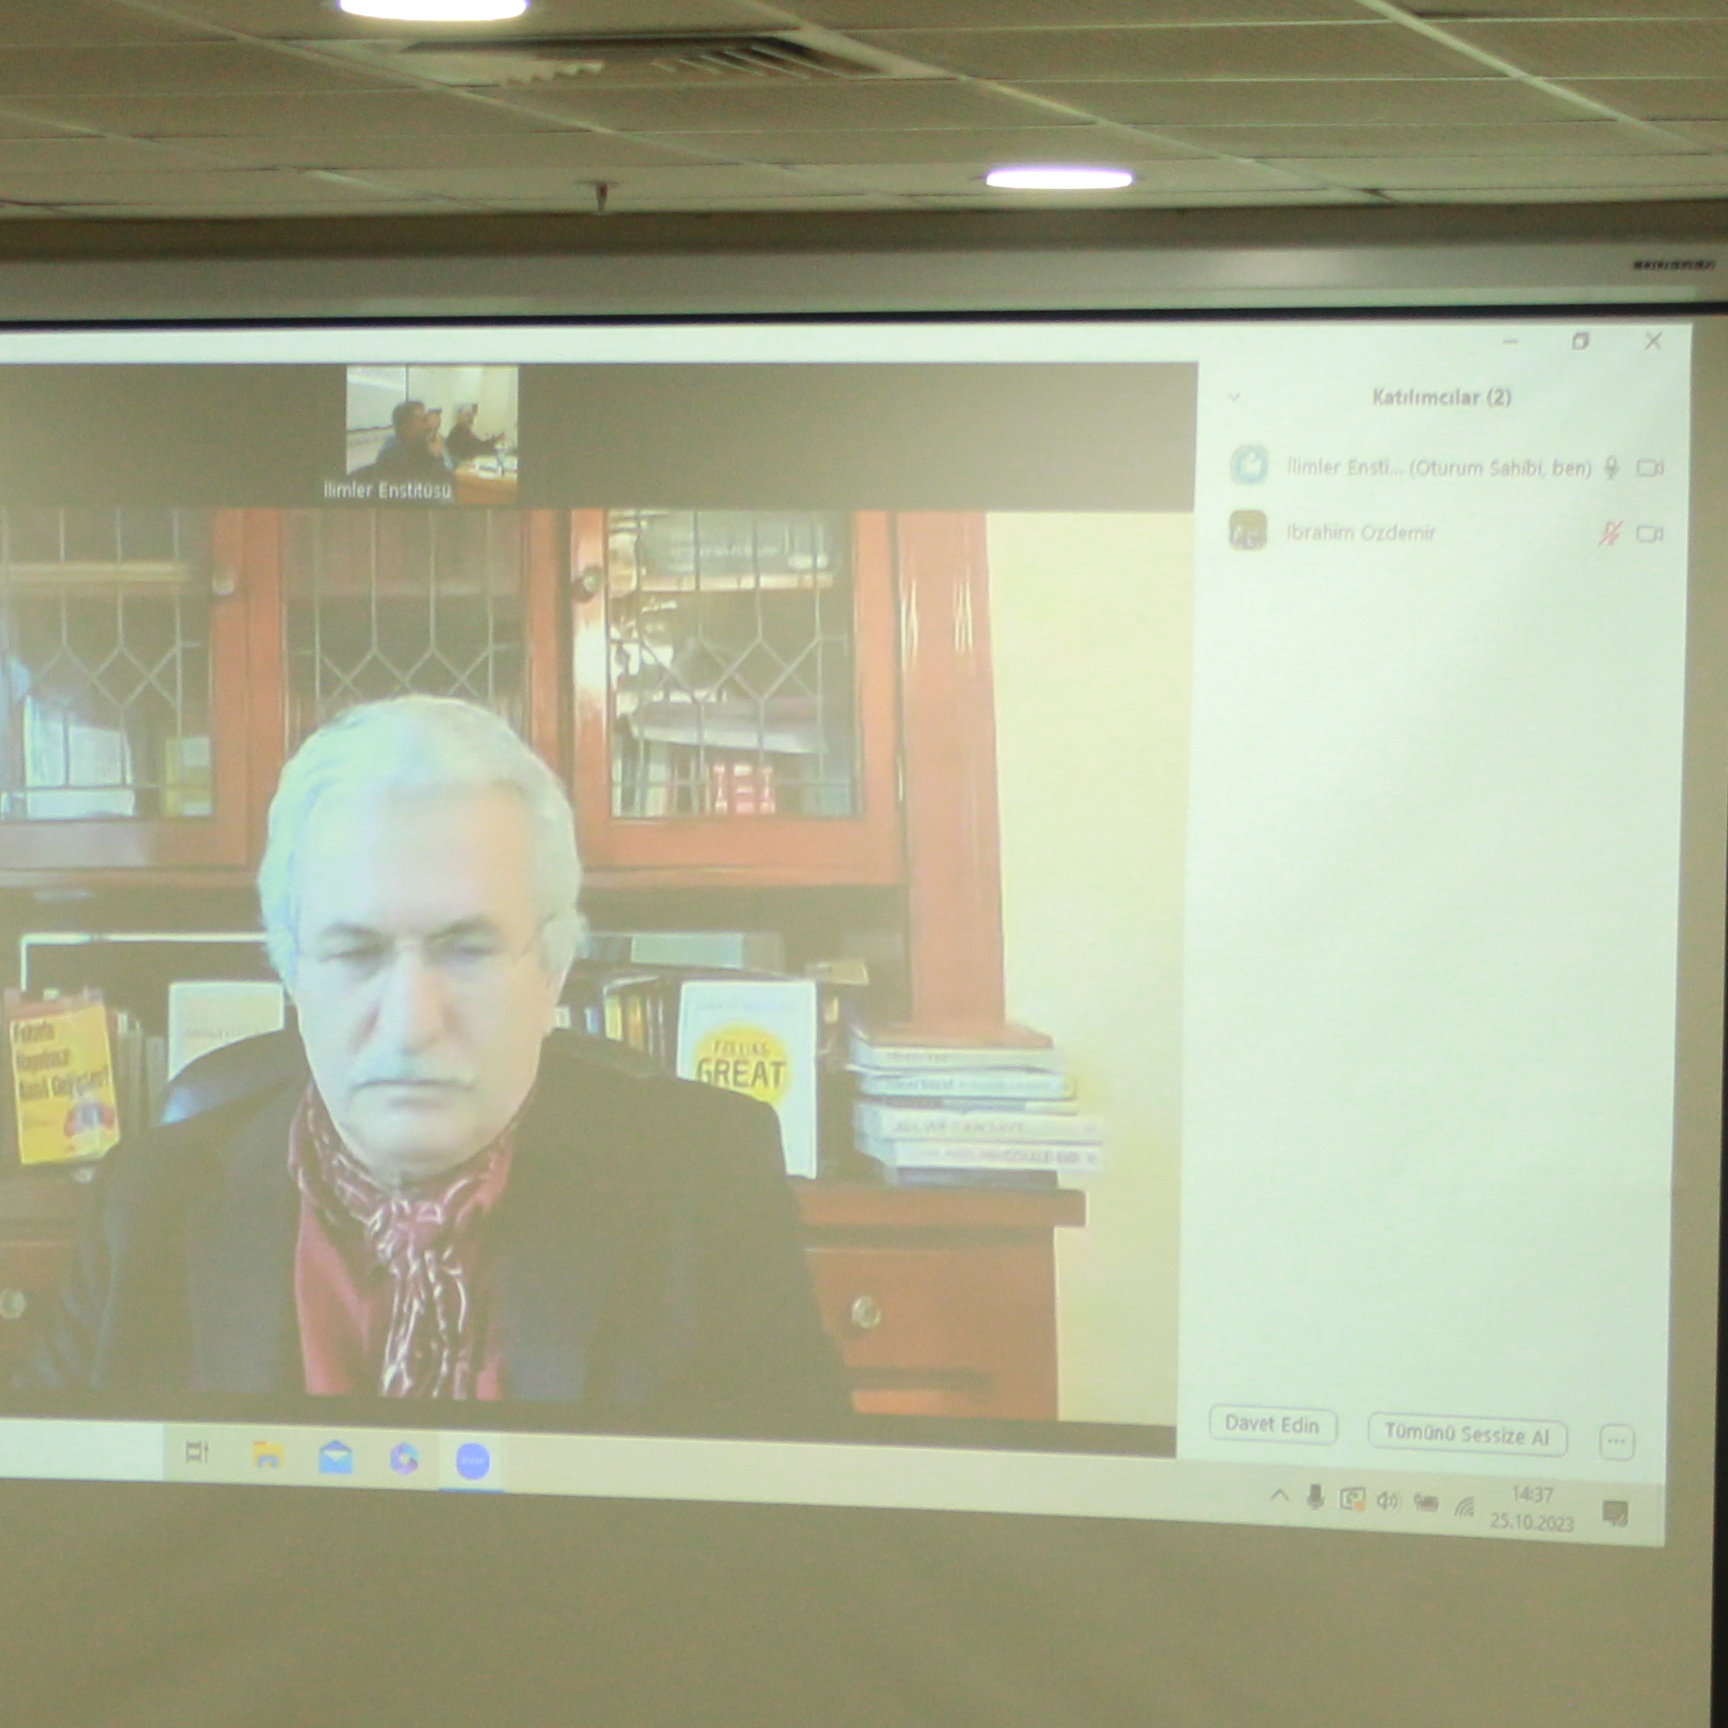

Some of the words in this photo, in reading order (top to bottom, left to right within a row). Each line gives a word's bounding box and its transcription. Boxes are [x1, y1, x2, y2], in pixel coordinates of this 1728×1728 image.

[1373, 388, 1479, 406] Katılımcılar
[1486, 388, 1512, 408] (2)
[1410, 459, 1483, 479] (Oturum
[1552, 459, 1592, 479] ben)
[696, 1058, 786, 1088] GREAT
[1225, 1414, 1274, 1431] Davet
[1281, 1416, 1320, 1434] Edin
[1386, 1421, 1455, 1441] Tümünü
[1462, 1425, 1525, 1445] Sessize
[1532, 1428, 1550, 1446] Al
[1513, 1486, 1554, 1503] 14:37
[1491, 1512, 1574, 1532] 25.10.2023
